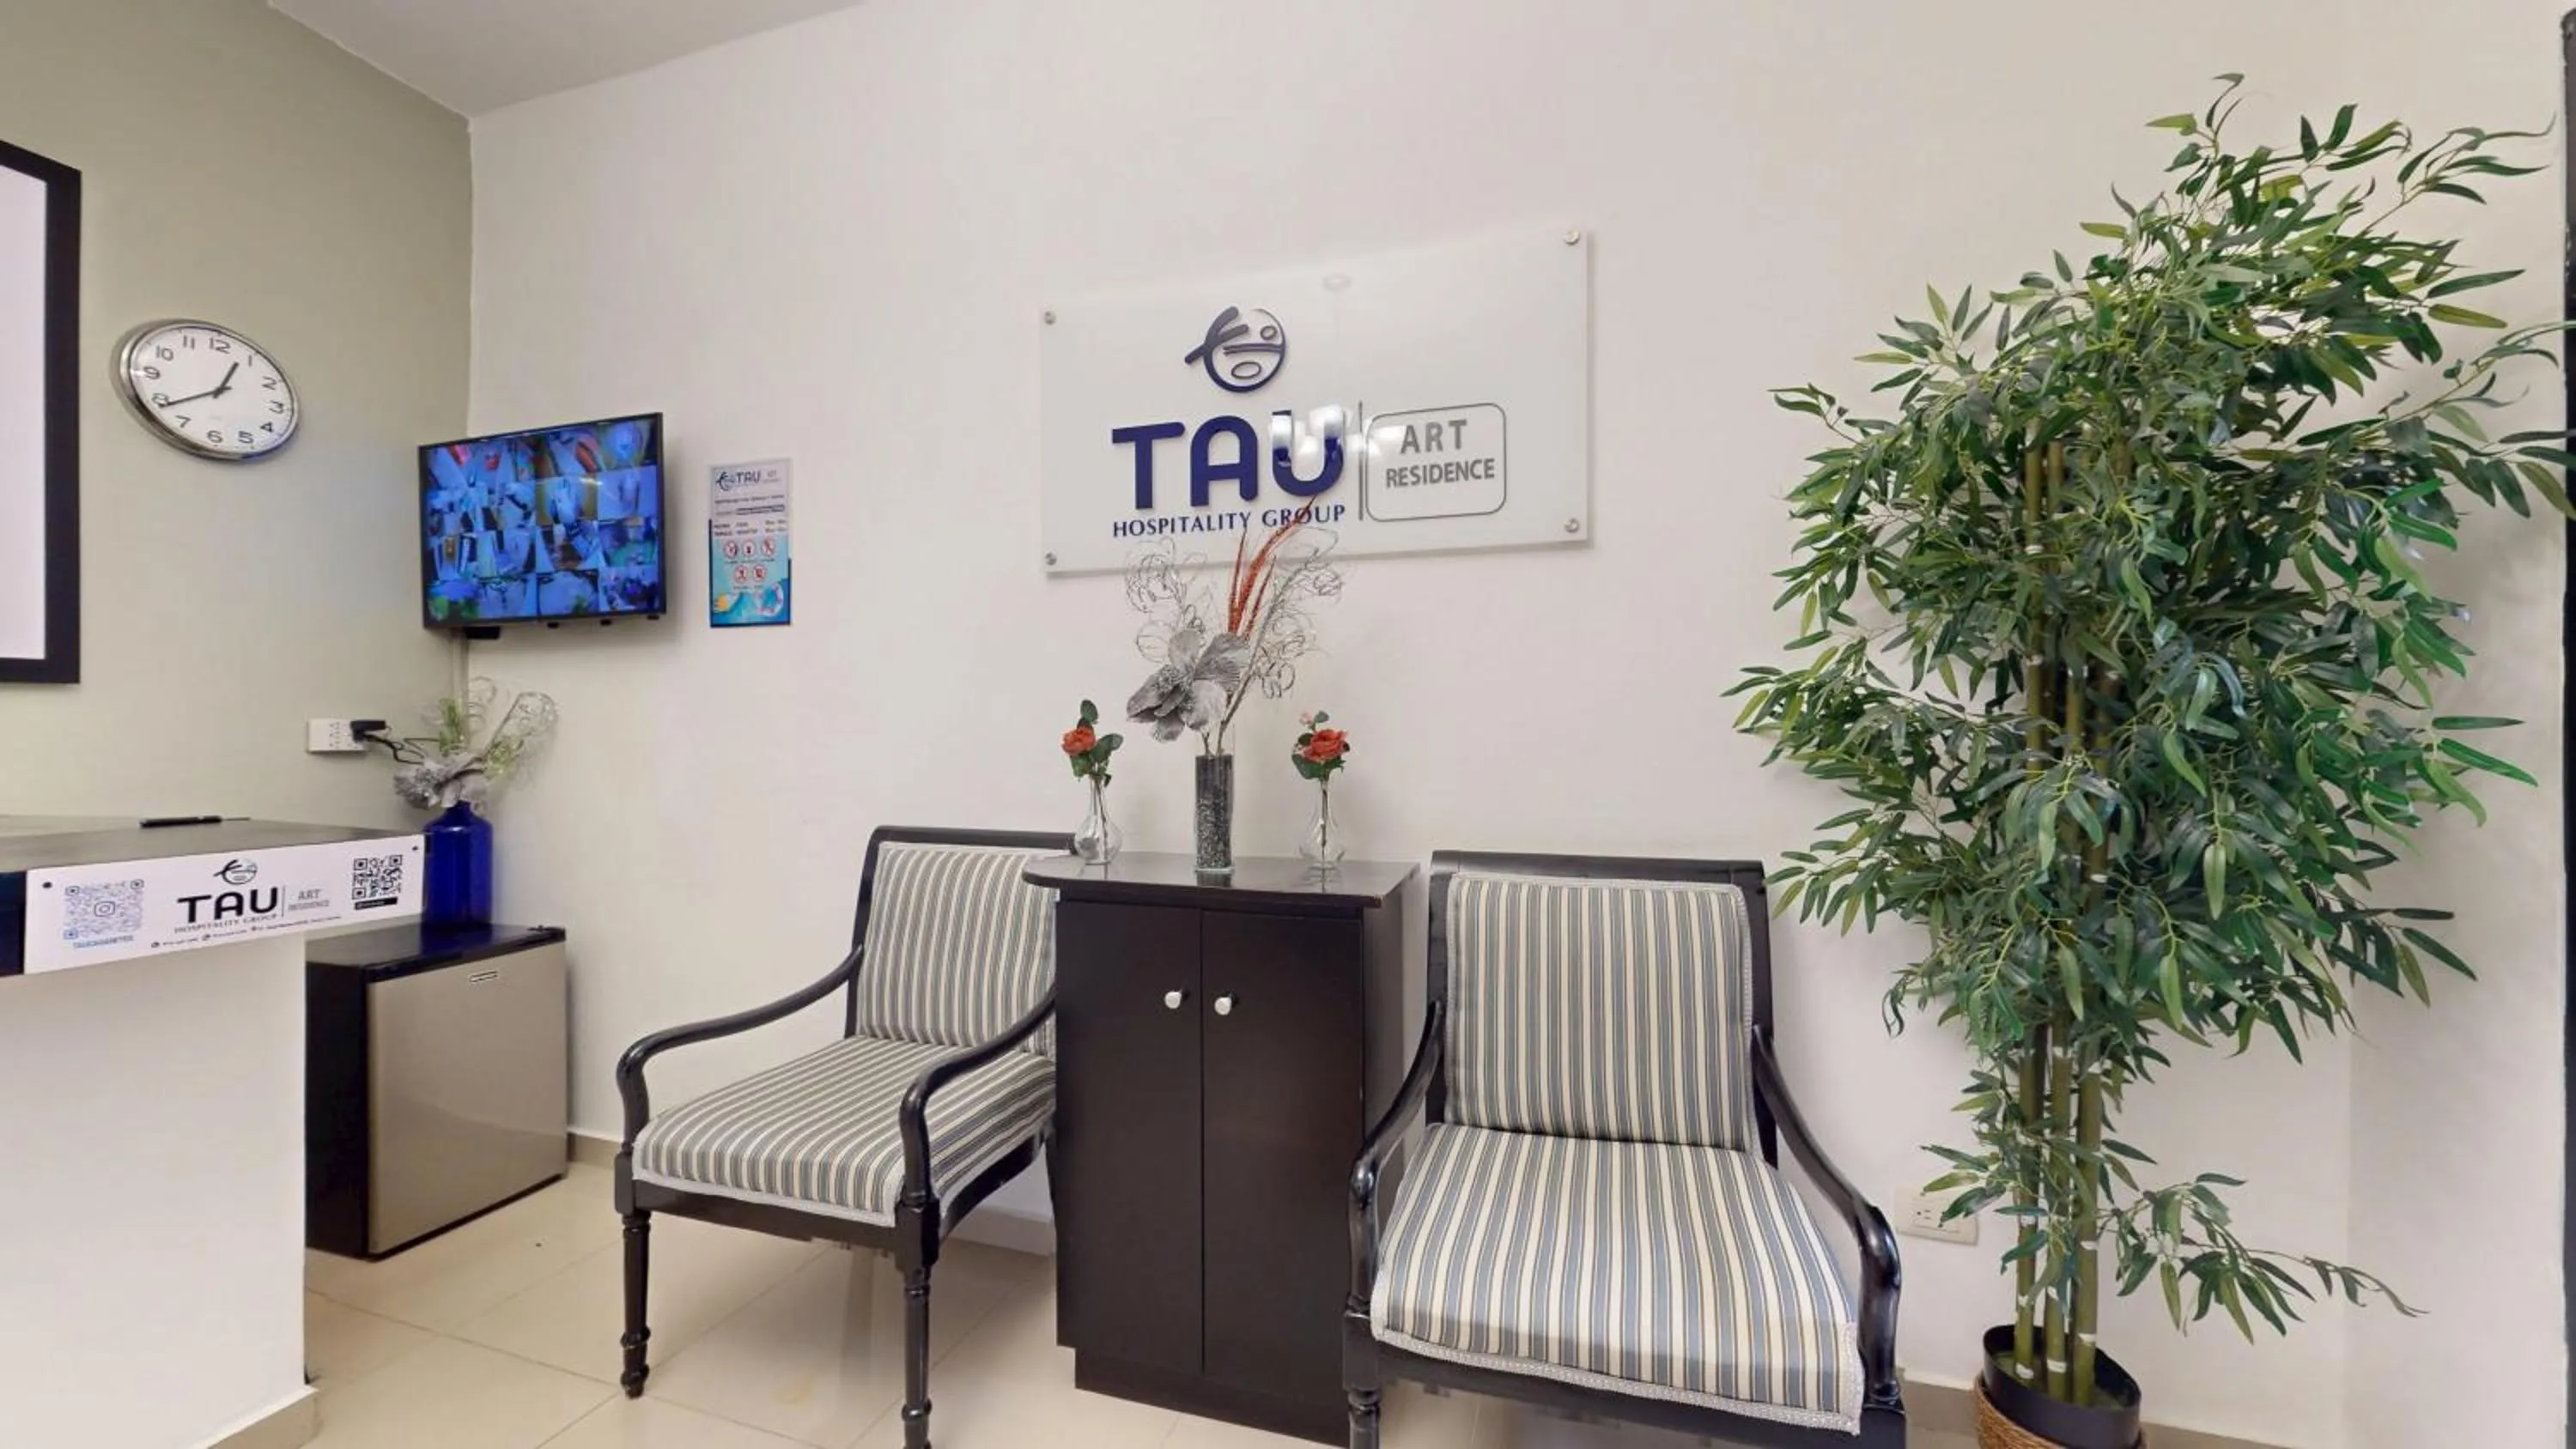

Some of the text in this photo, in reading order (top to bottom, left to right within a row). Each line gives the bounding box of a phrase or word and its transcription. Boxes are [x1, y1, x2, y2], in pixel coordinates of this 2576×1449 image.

[183, 336, 195, 350] 11
[210, 337, 230, 354] 12
[156, 346, 173, 361] 10
[247, 355, 252, 367] 1
[143, 367, 161, 379] 9
[262, 376, 277, 390] 2
[151, 392, 169, 408] 8
[269, 400, 284, 414] 3
[176, 415, 191, 428] 7
[259, 421, 273, 433] 4
[207, 430, 223, 444] 6
[238, 430, 254, 444] 5
[1400, 419, 1467, 454] ART
[1113, 408, 1345, 509] TAU
[737, 470, 761, 483] TAU
[1386, 458, 1495, 489] RESIDENCE
[1113, 504, 1346, 537] HOSPITALITY GROUP
[298, 888, 321, 900] ART
[177, 887, 277, 923] TAU
